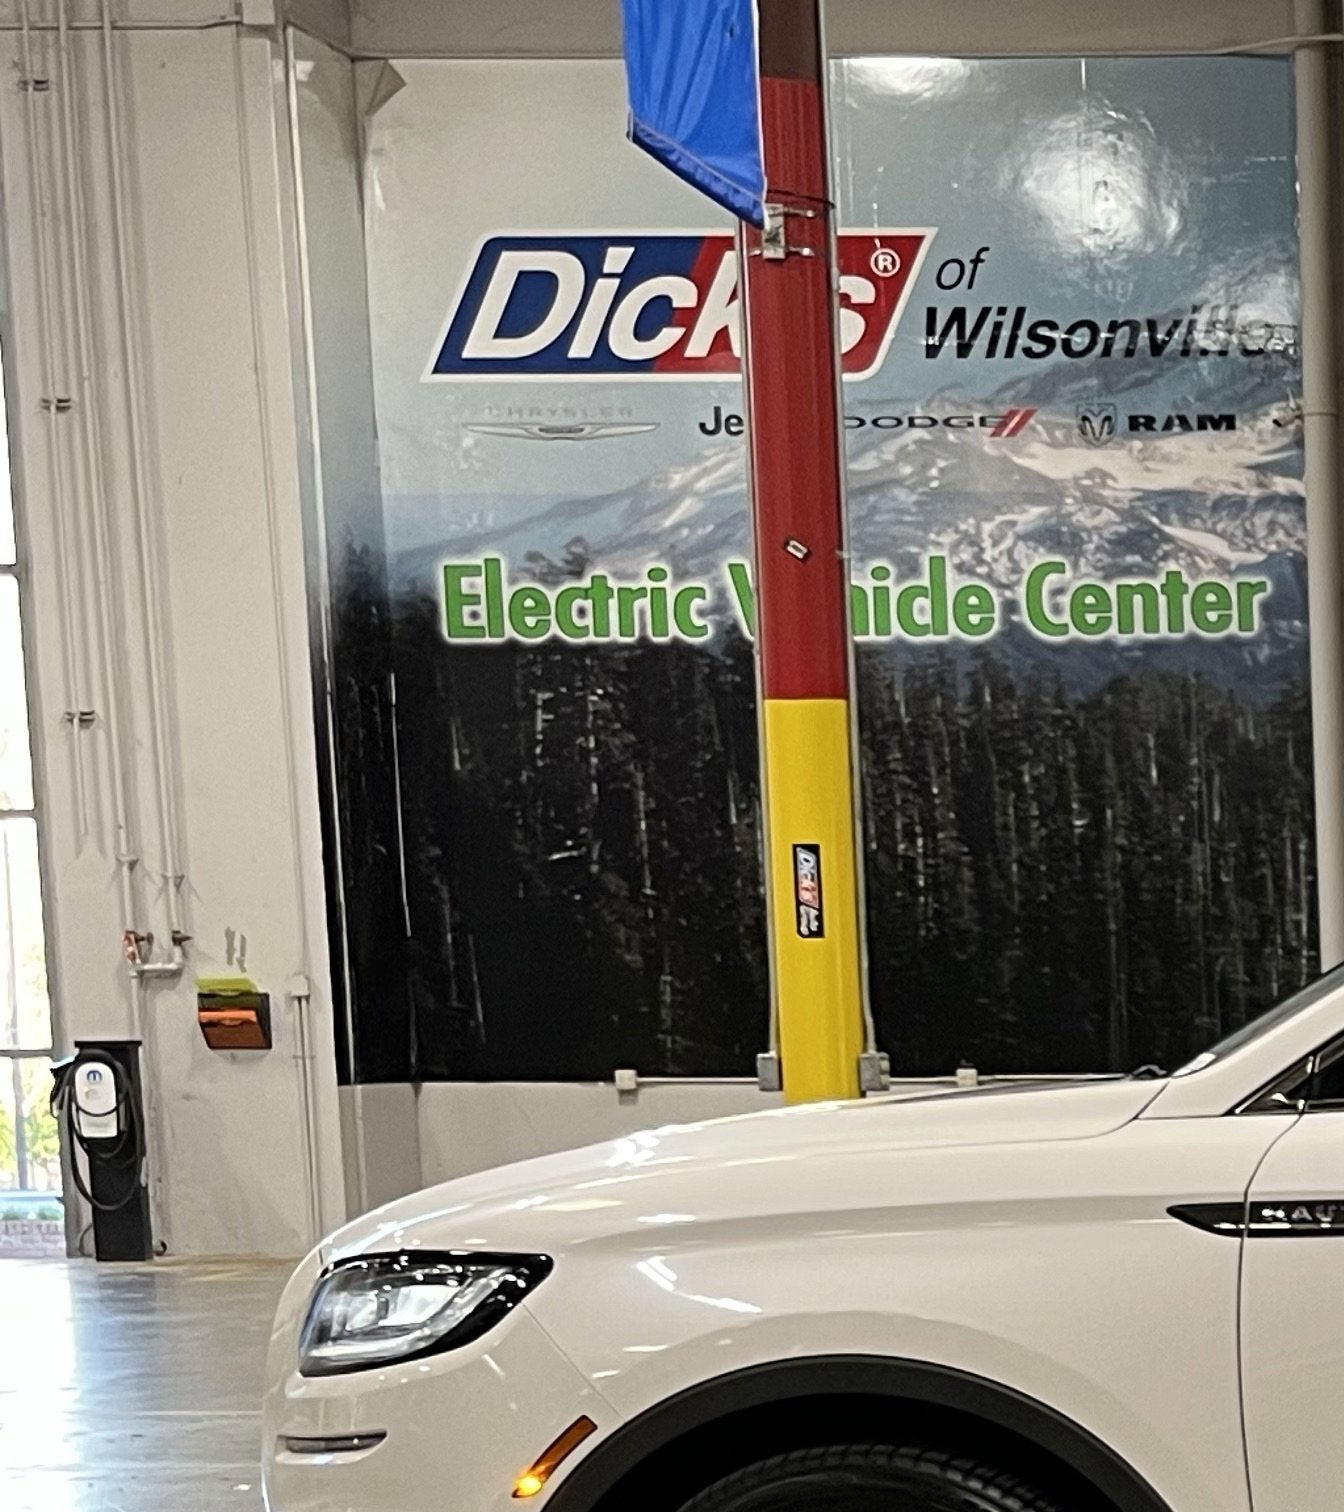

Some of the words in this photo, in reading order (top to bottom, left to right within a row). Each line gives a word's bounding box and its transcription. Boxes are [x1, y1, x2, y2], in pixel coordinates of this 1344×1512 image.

[935, 247, 990, 290] of
[460, 246, 876, 361] Dicks
[699, 406, 744, 436] Je
[1128, 414, 1237, 432] RAM
[443, 558, 709, 639] Electric
[728, 555, 996, 637] Vicle
[1025, 561, 1268, 637] Center
